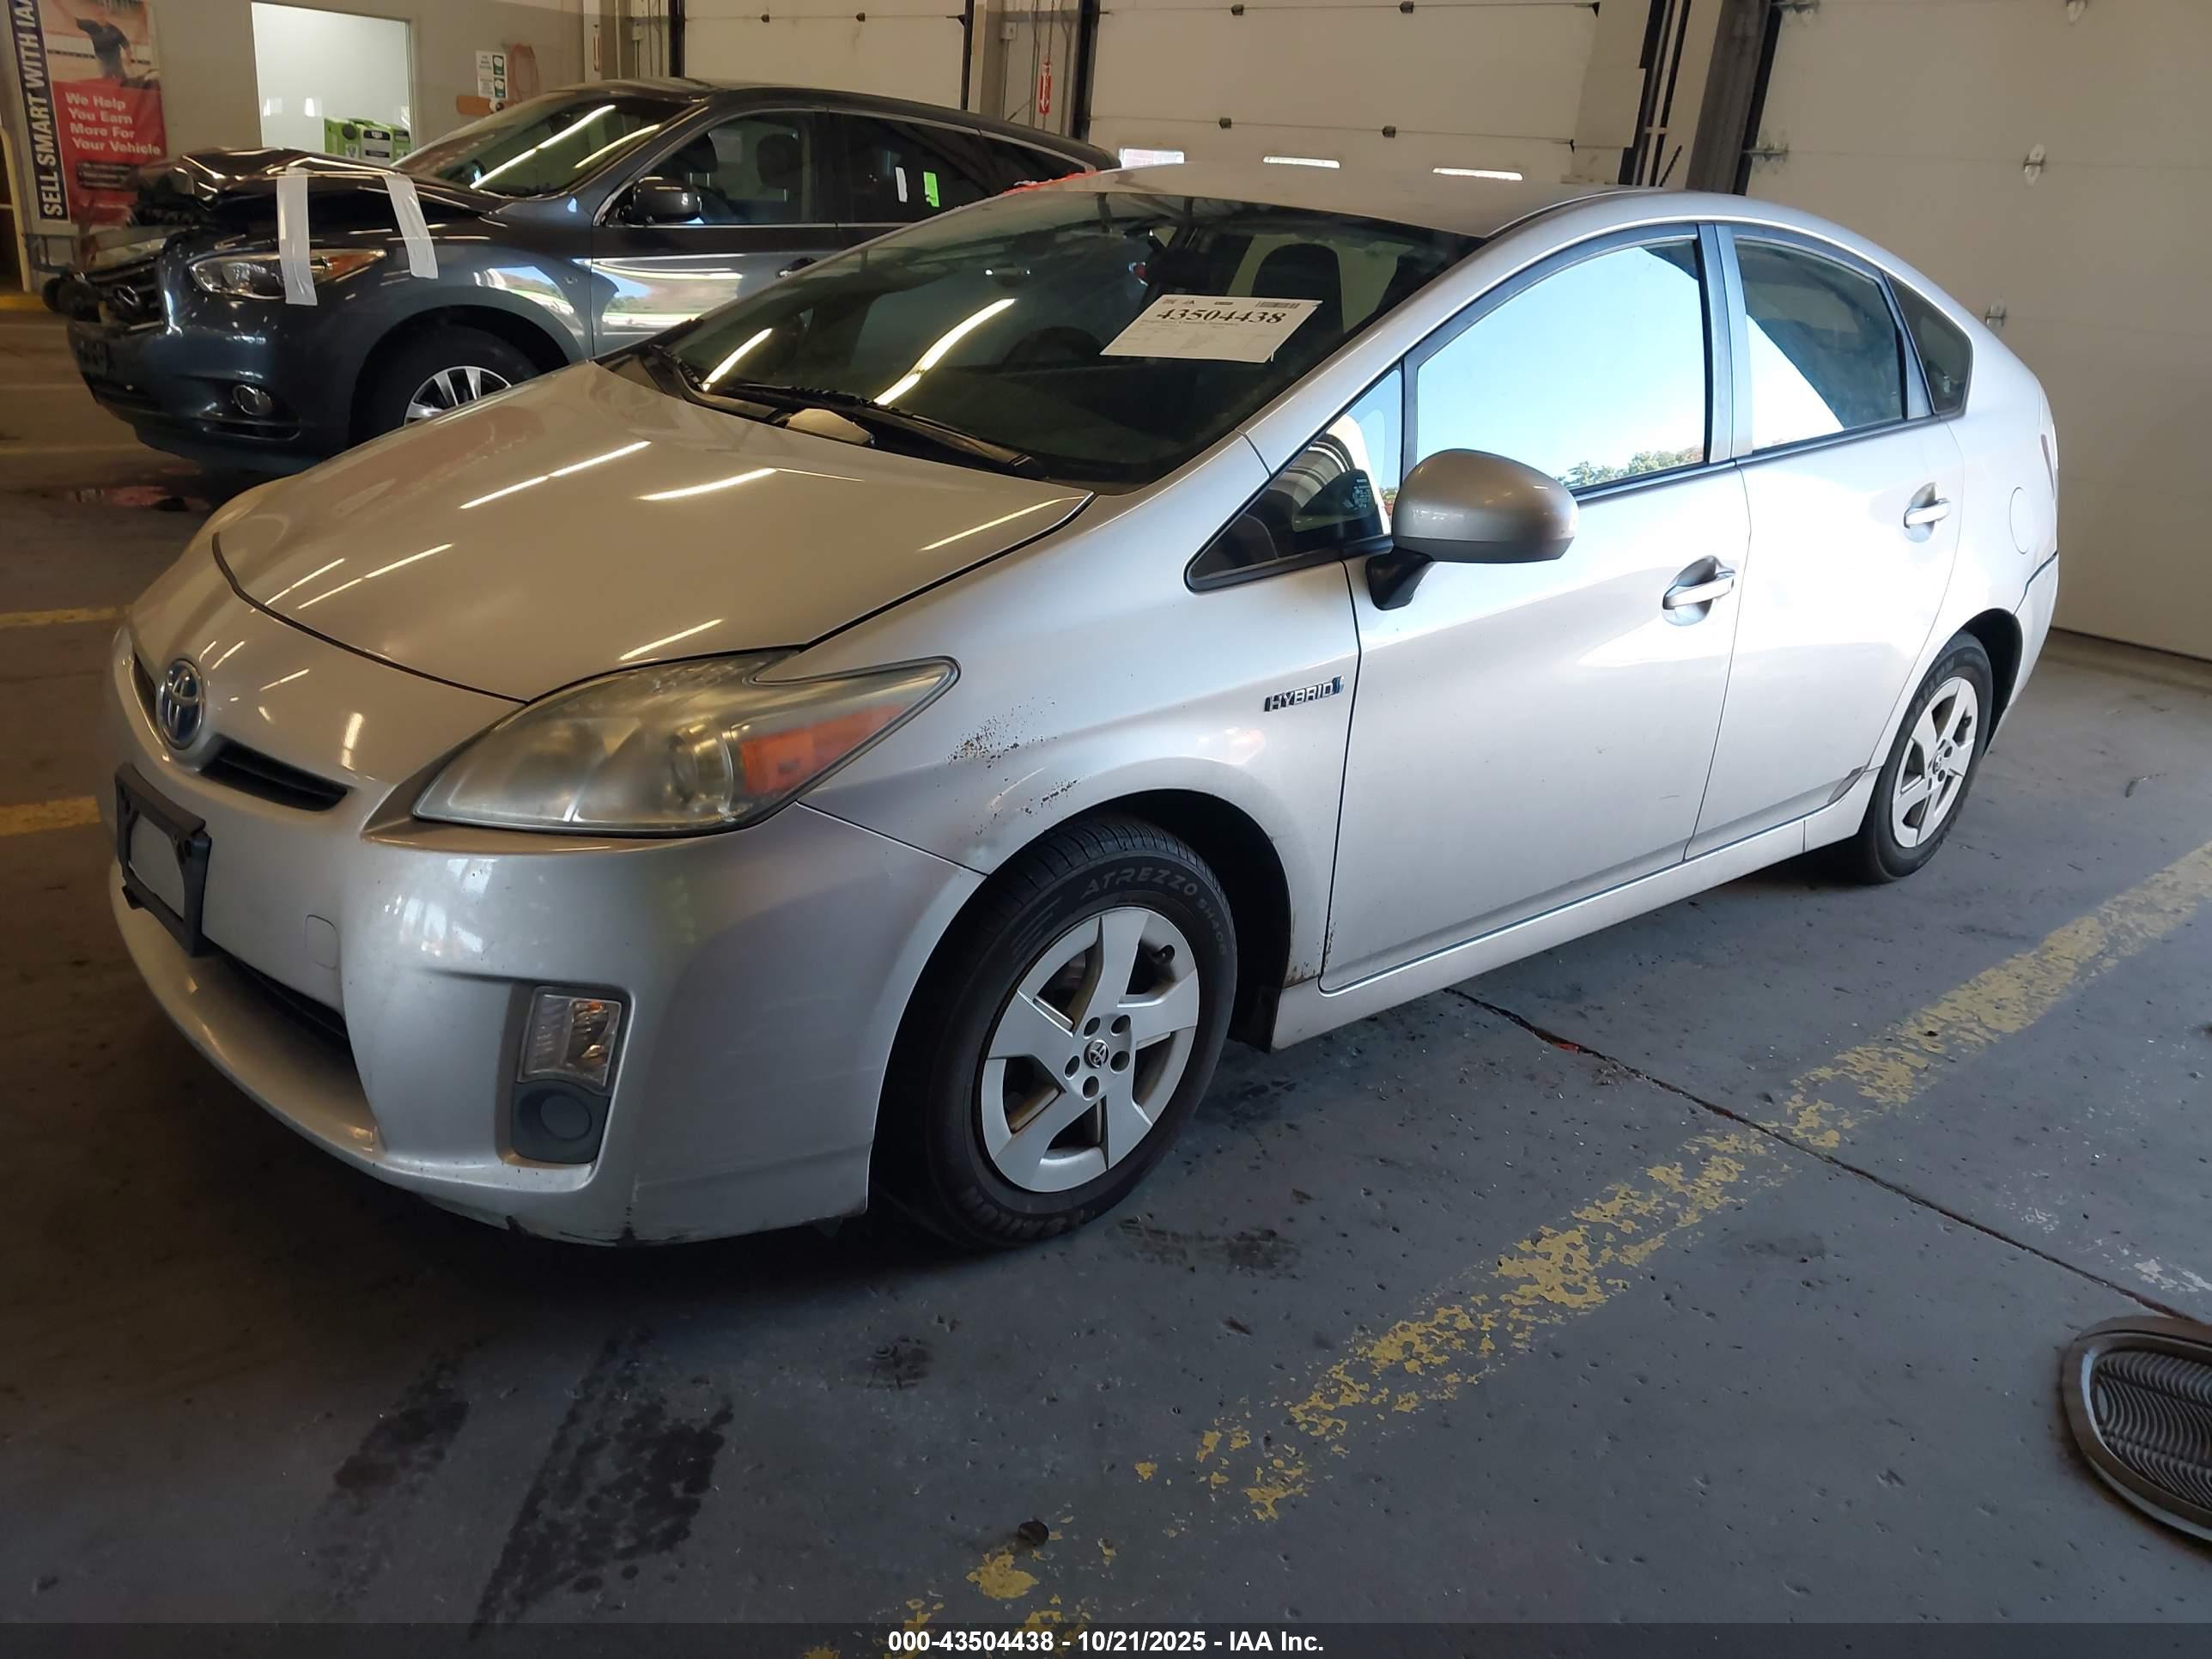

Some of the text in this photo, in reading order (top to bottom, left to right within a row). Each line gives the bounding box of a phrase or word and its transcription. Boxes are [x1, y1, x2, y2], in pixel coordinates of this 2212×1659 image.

[18, 33, 45, 88] WITH
[65, 92, 126, 112] We Help
[69, 107, 133, 125] You Earn
[27, 91, 56, 167] SMART
[70, 122, 136, 138] More For
[71, 137, 161, 155] Your Vehicle
[43, 168, 63, 216] SELL
[1156, 308, 1287, 325] 43504438
[1265, 681, 1336, 712] HYBRID
[1081, 866, 1199, 900] ATREZZO
